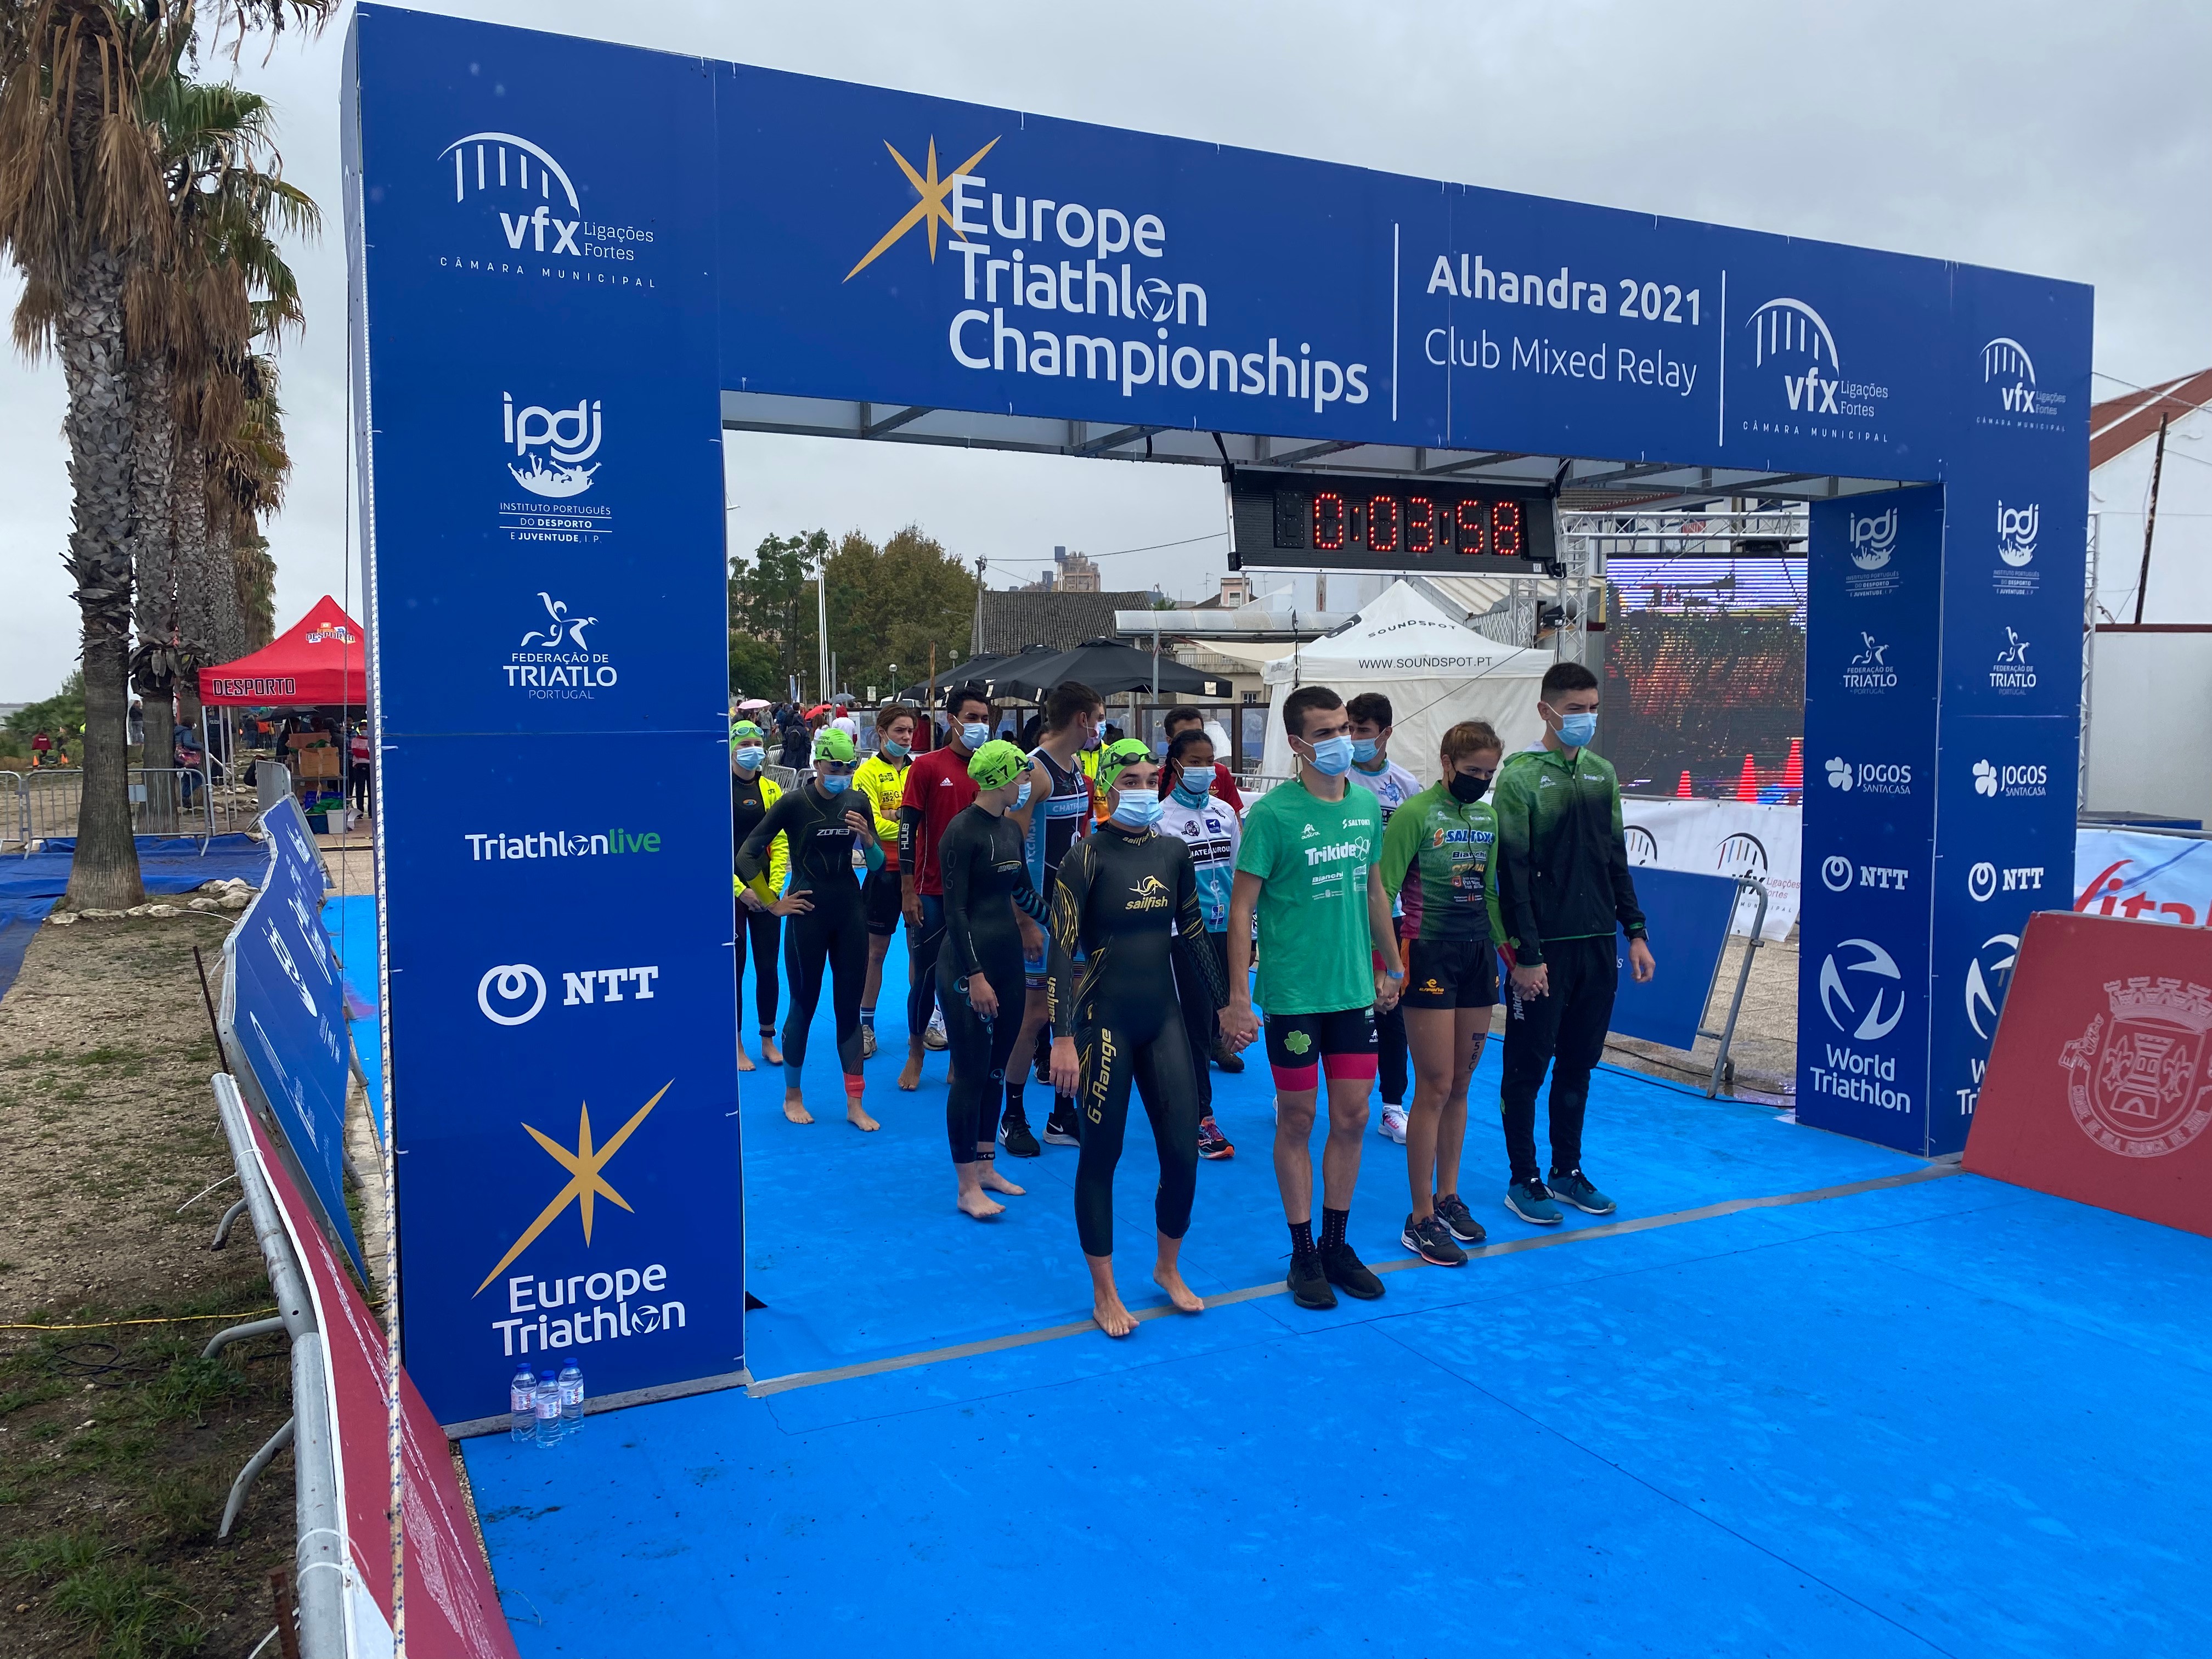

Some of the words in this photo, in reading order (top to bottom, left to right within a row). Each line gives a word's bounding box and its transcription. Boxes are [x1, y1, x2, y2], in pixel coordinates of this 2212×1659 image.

[952, 173, 1166, 259] Europe
[500, 206, 582, 256] vfx
[584, 221, 654, 243] Ligações
[584, 242, 634, 261] Fortes
[441, 256, 524, 274] CÂMARA
[543, 268, 655, 288] MUNICIPAL
[949, 240, 1207, 326] Triathlon
[1427, 255, 1607, 315] Alhandra
[1620, 279, 1700, 326] 2021
[949, 308, 1369, 413] Championships
[1425, 326, 1500, 370] Club
[1512, 337, 1607, 381] Mixed
[1619, 348, 1698, 397] Relay
[1785, 367, 1838, 414] vfx
[1841, 380, 1888, 399] Ligações
[2002, 382, 2035, 413] vfx
[2036, 390, 2067, 404] Ligações
[1841, 401, 1875, 417] Fortes
[2036, 404, 2057, 415] Fortes
[503, 391, 602, 462] ipdj
[1743, 420, 1799, 435] CÂMARA
[1812, 427, 1888, 443] MUNICIPAL
[2017, 421, 2066, 432] MUNICIPAL
[500, 503, 550, 513] INSTITUTO
[553, 504, 611, 516] PORTUGUÊS
[1997, 499, 2039, 544] ipdj
[520, 517, 535, 526] DO
[537, 519, 592, 528] DESPORTO
[1314, 493, 1520, 555] 0:03:58
[1850, 507, 1898, 549] ipdj
[510, 531, 515, 540] E
[1368, 620, 1457, 638] SOUNDSPOT
[511, 651, 589, 664] FEDERAÇÃO
[593, 653, 609, 663] DE
[1358, 657, 1493, 670] WWW.SOUNDSPOT.PT
[212, 678, 296, 697] DESPORTO
[503, 665, 618, 687] TRIATLO
[1843, 674, 1898, 688] TRIATLO
[1989, 673, 2037, 687] TRIATLO
[528, 689, 595, 700] PORTUGAL
[1857, 763, 1911, 787] JOGOS
[2001, 765, 2047, 792] JOGOS
[465, 828, 661, 860] Triathlonlive
[901, 823, 910, 850] HUUB
[1312, 871, 1344, 883] Bianchi
[1860, 866, 1908, 890] NTT
[2002, 867, 2044, 890] NTT
[1125, 896, 1168, 912] sailfish
[562, 966, 659, 1006] NTT
[1047, 977, 1059, 1023] sailfish
[1826, 1043, 1895, 1081] World
[1087, 1028, 1117, 1124] G-Range
[1810, 1067, 1910, 1113] Triathlon
[509, 1263, 667, 1313] Europe
[492, 1301, 686, 1356] Triathlon
